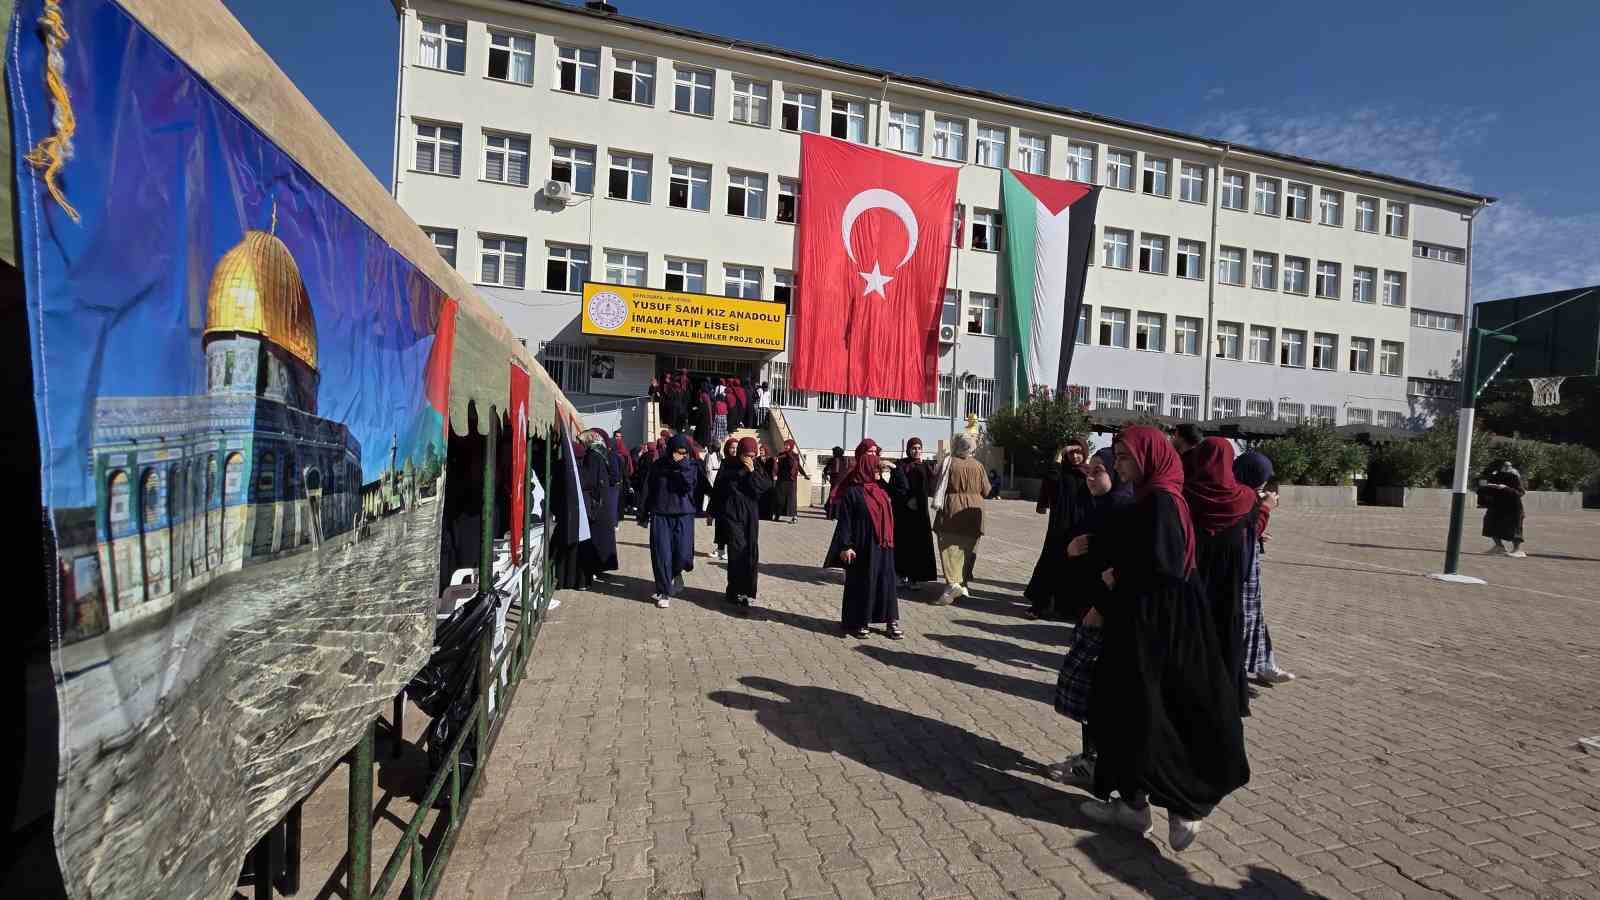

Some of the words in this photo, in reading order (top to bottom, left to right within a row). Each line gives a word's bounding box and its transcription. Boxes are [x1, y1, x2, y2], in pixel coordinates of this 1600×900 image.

[633, 300, 672, 311] YUSUF
[676, 304, 703, 314] SAMİ
[707, 308, 725, 317] KIZ
[730, 311, 780, 322] ANADOLU
[632, 312, 701, 327] İMAM-HATİP
[705, 320, 739, 332] LİSESİ
[631, 326, 646, 334] FEN
[659, 328, 689, 338] SOSYAL
[729, 335, 753, 344] PROJE
[755, 338, 780, 346] OKULU
